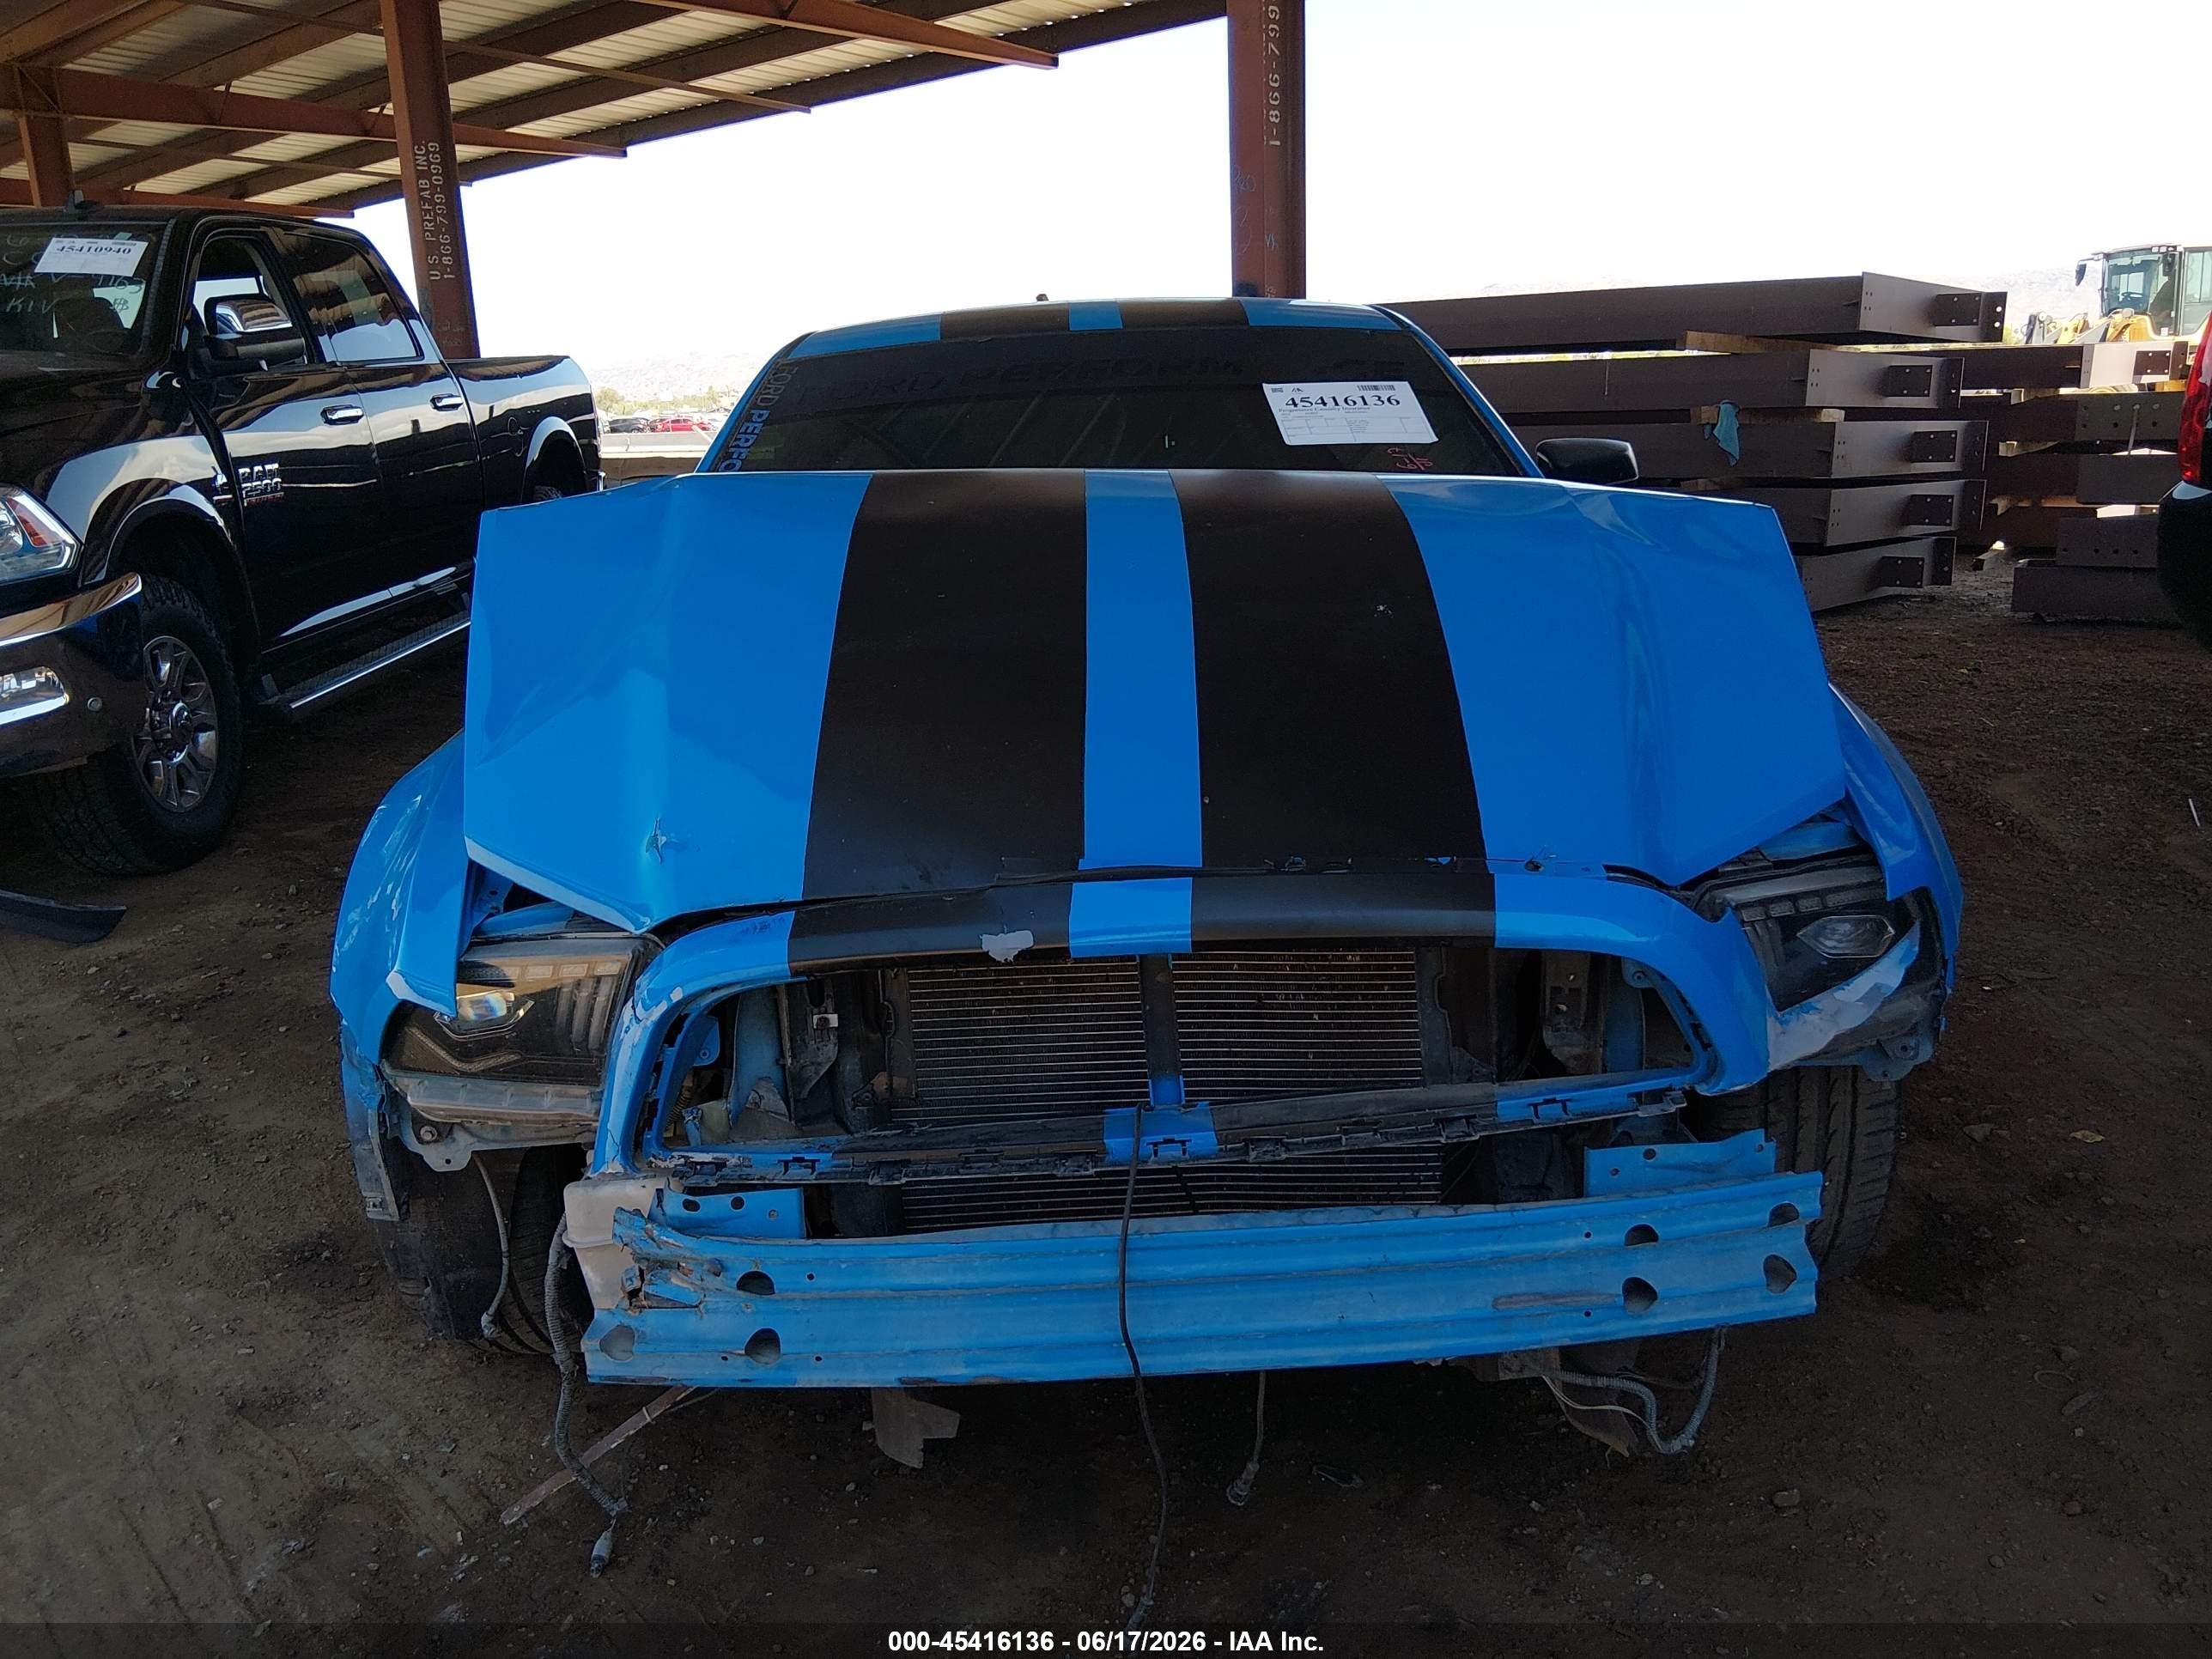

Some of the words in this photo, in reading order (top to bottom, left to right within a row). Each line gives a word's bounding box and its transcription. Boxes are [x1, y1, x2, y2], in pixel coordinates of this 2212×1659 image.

[414, 140, 429, 171] INC.
[418, 179, 437, 241] PREFAB
[428, 142, 456, 280] 1-866-799-0969
[57, 246, 131, 255] 45410940
[757, 358, 799, 407] FORD
[1285, 394, 1401, 408] 45416136
[718, 409, 771, 472] PERFO
[238, 463, 280, 483] RAM
[241, 478, 283, 498] 2500
